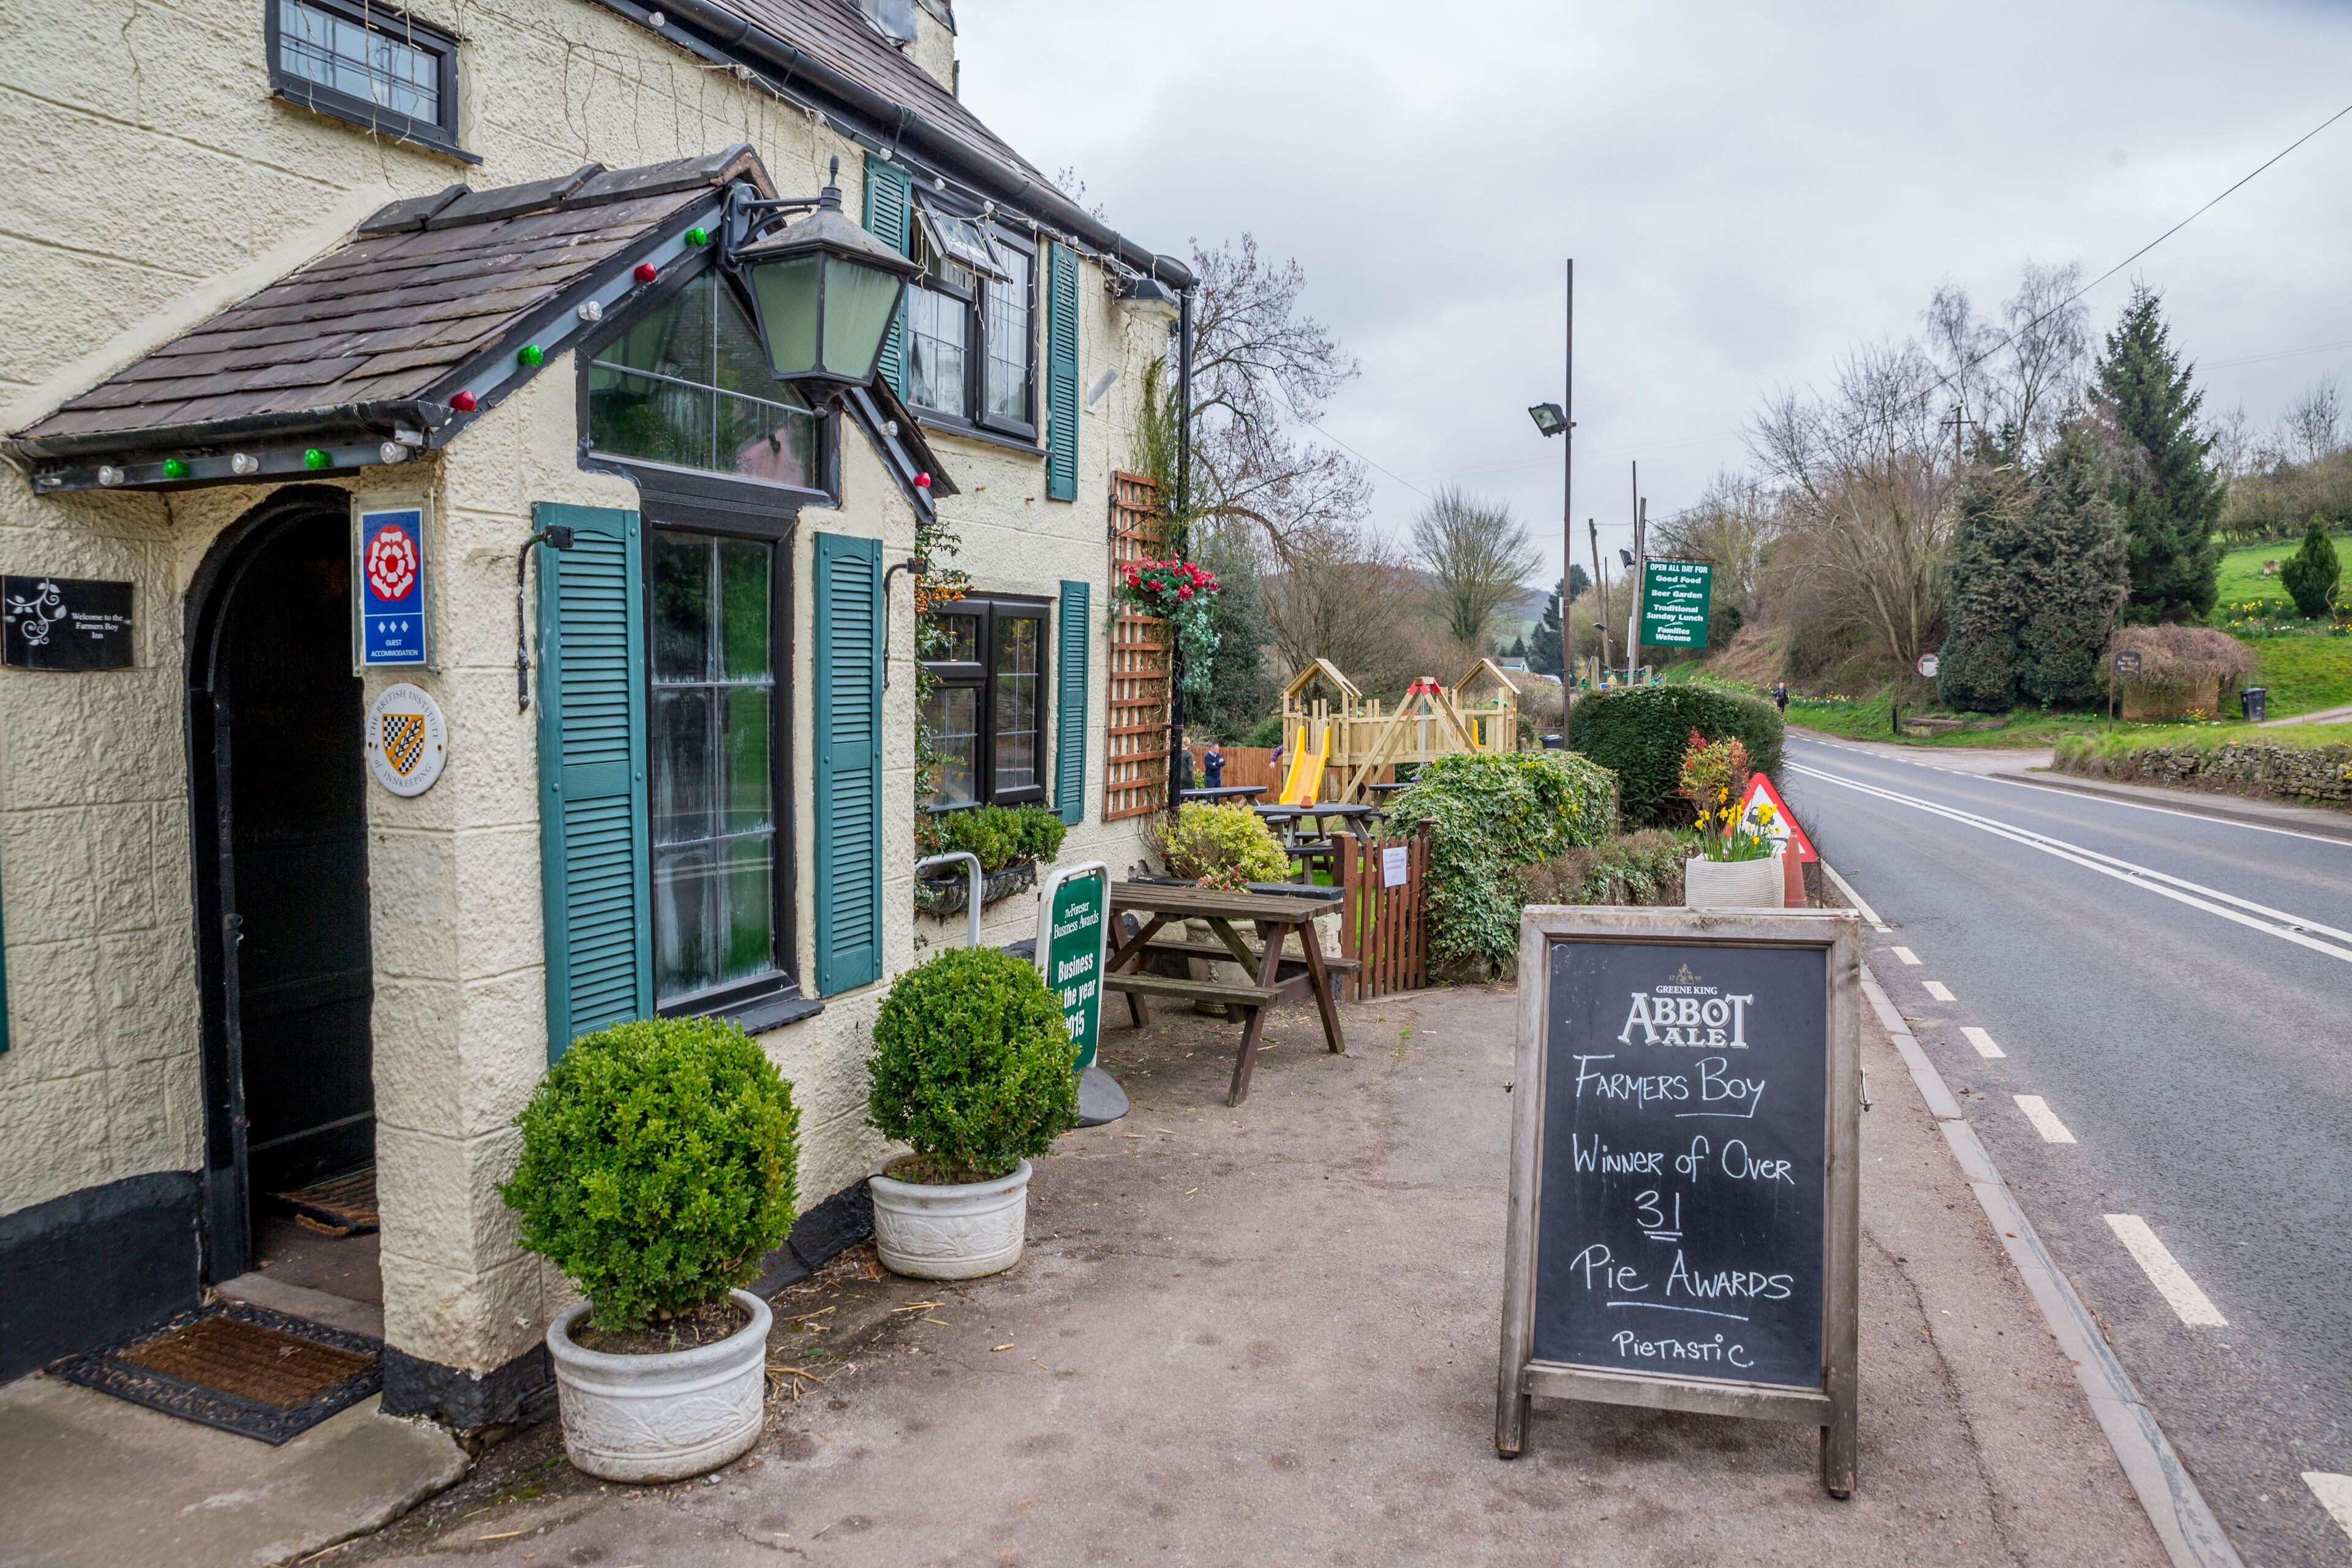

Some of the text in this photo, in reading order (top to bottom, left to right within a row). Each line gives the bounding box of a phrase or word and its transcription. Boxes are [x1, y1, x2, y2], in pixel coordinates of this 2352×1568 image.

[71, 612, 104, 621] Welcome
[1646, 612, 1676, 622] Sunday
[1653, 604, 1698, 613] Traditional
[1656, 633, 1692, 642] Welcome
[370, 690, 439, 741] THE BRITISH INSTITUTE
[383, 764, 432, 787] INNKEEPING
[1071, 902, 1090, 917] Forester
[1054, 910, 1099, 940] Business Awards
[1058, 952, 1093, 984] Business
[1064, 986, 1077, 1009] the
[1078, 978, 1096, 1006] year
[1656, 985, 1718, 995] GREENE KING
[1617, 992, 1754, 1049] ABBOT
[1661, 1027, 1728, 1048] ALE
[1675, 1135, 1709, 1183] of
[1634, 1190, 1680, 1229] 31
[1570, 1244, 1649, 1292] Pie
